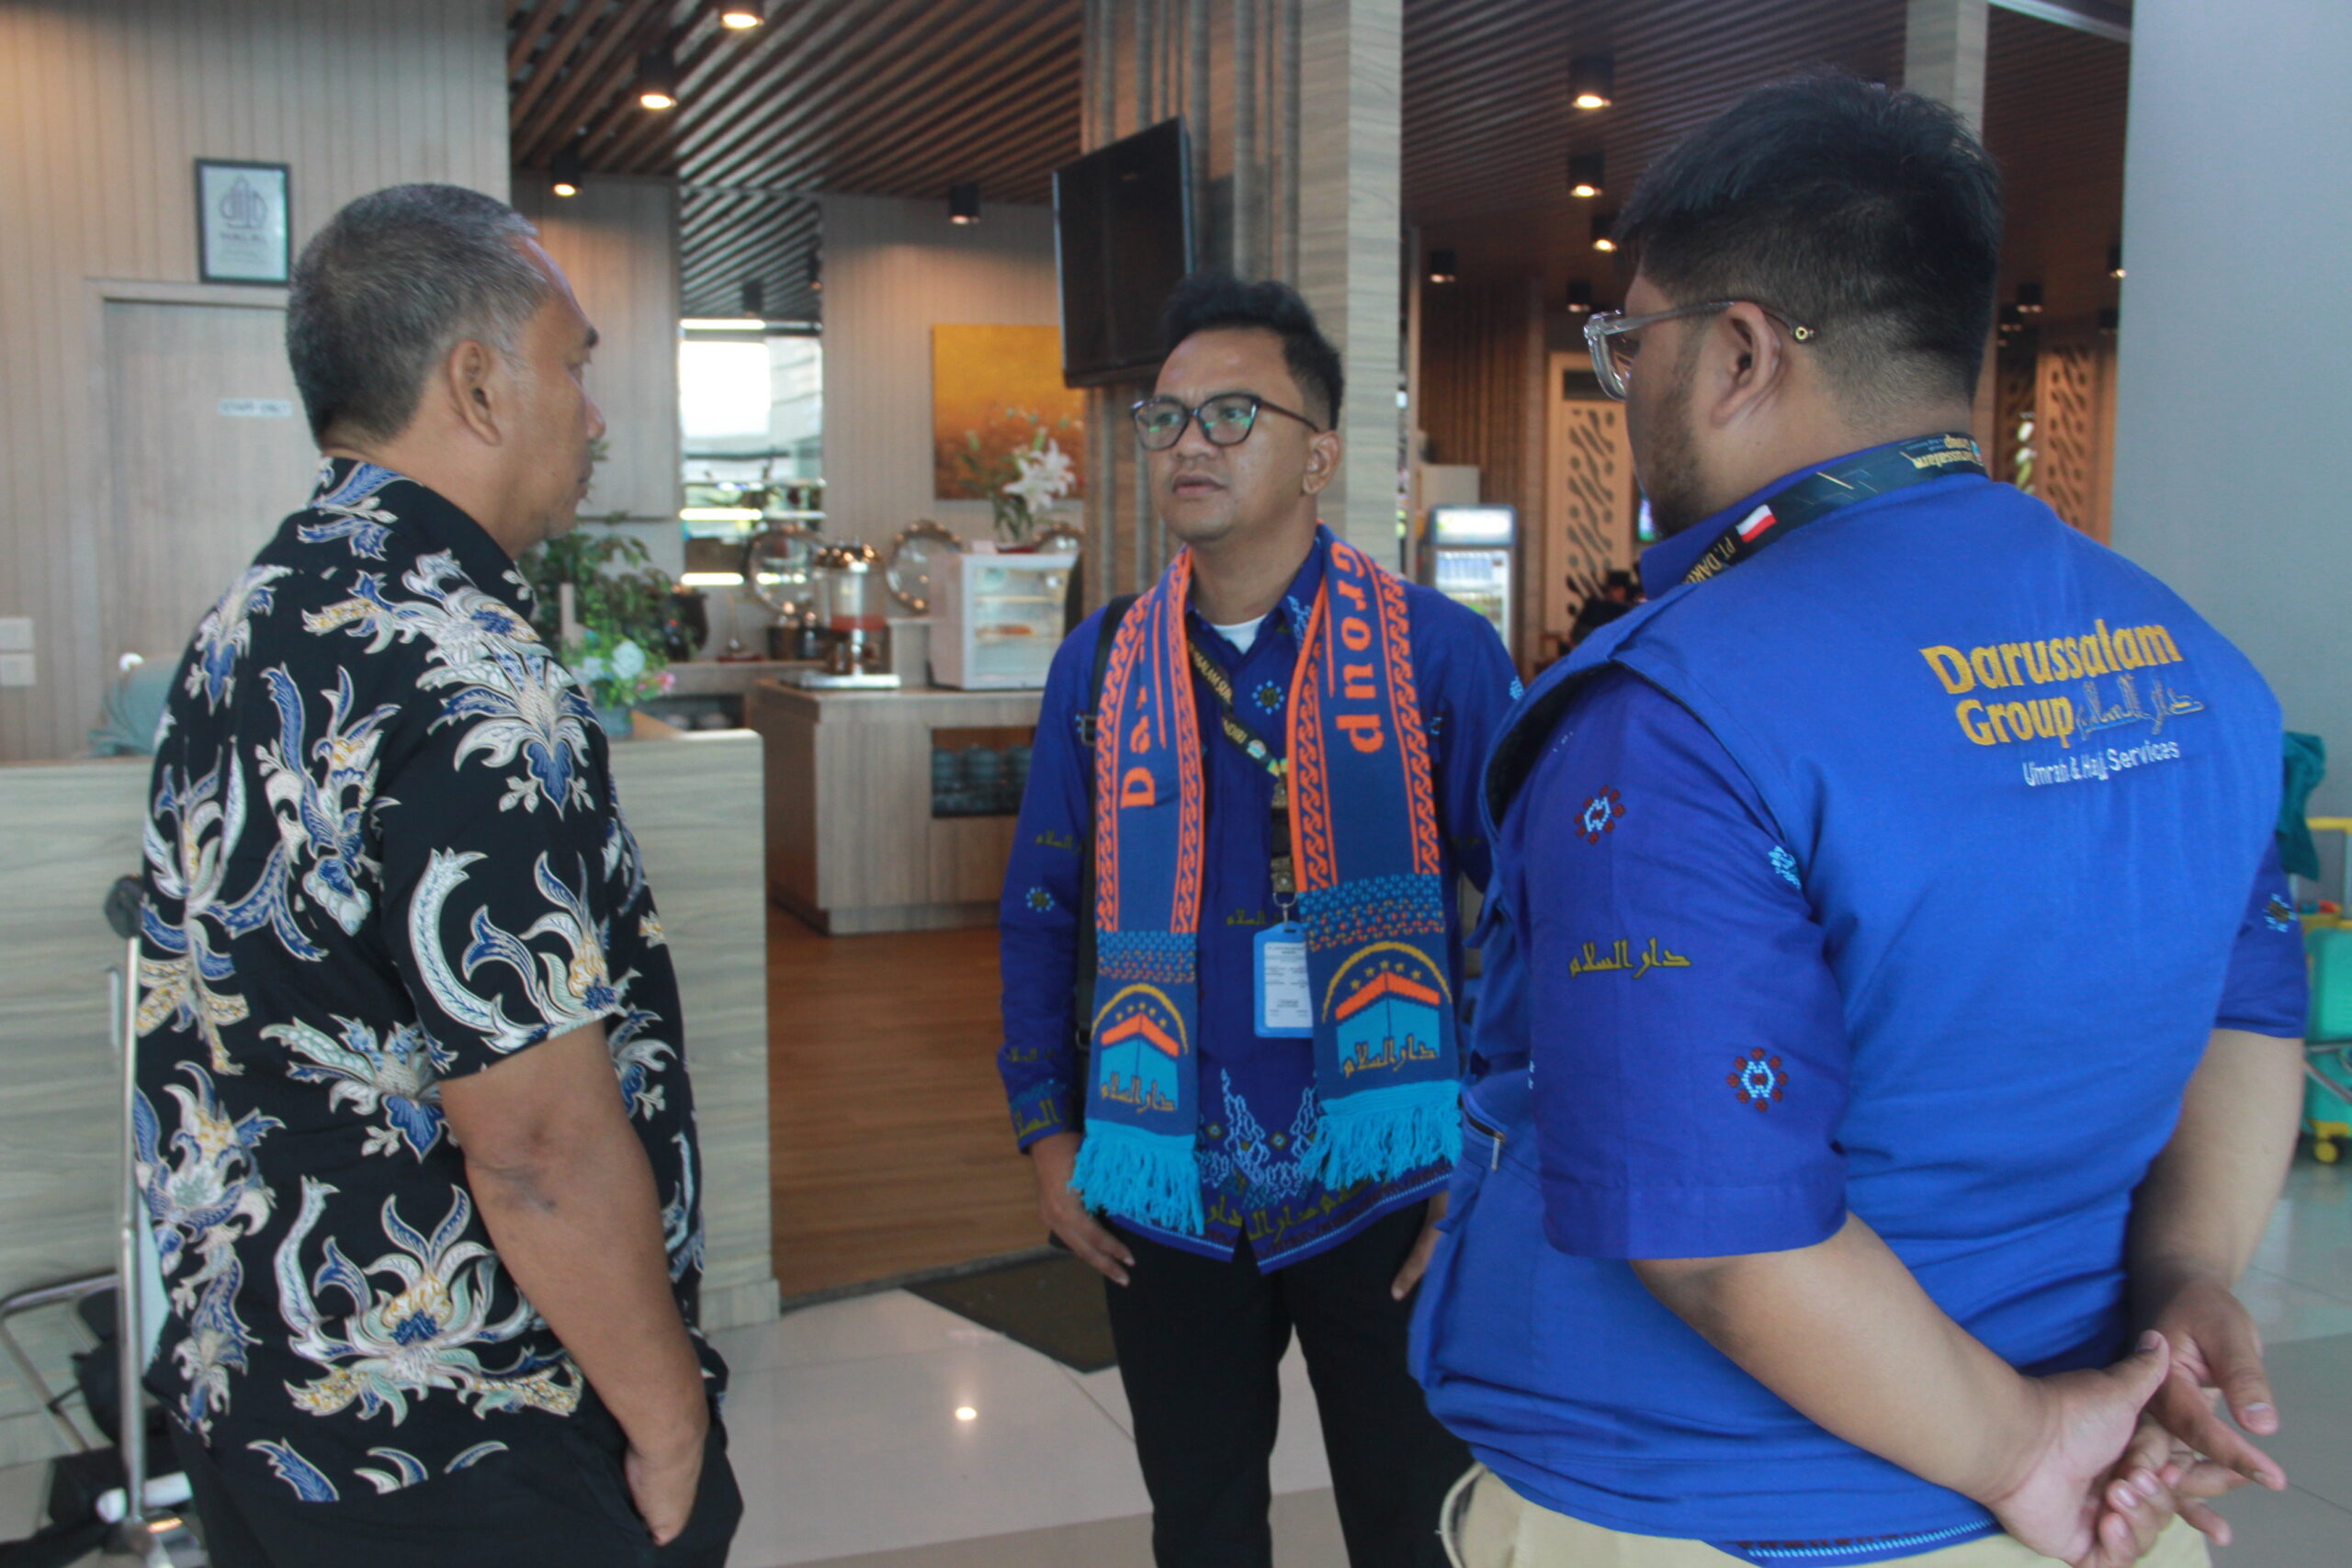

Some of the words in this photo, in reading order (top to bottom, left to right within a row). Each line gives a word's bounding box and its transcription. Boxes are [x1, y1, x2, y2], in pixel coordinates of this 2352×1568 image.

[1330, 542, 1385, 753] Group
[1919, 618, 2184, 694] Darussalam
[1956, 696, 2075, 748] Group
[2107, 739, 2181, 771] Services
